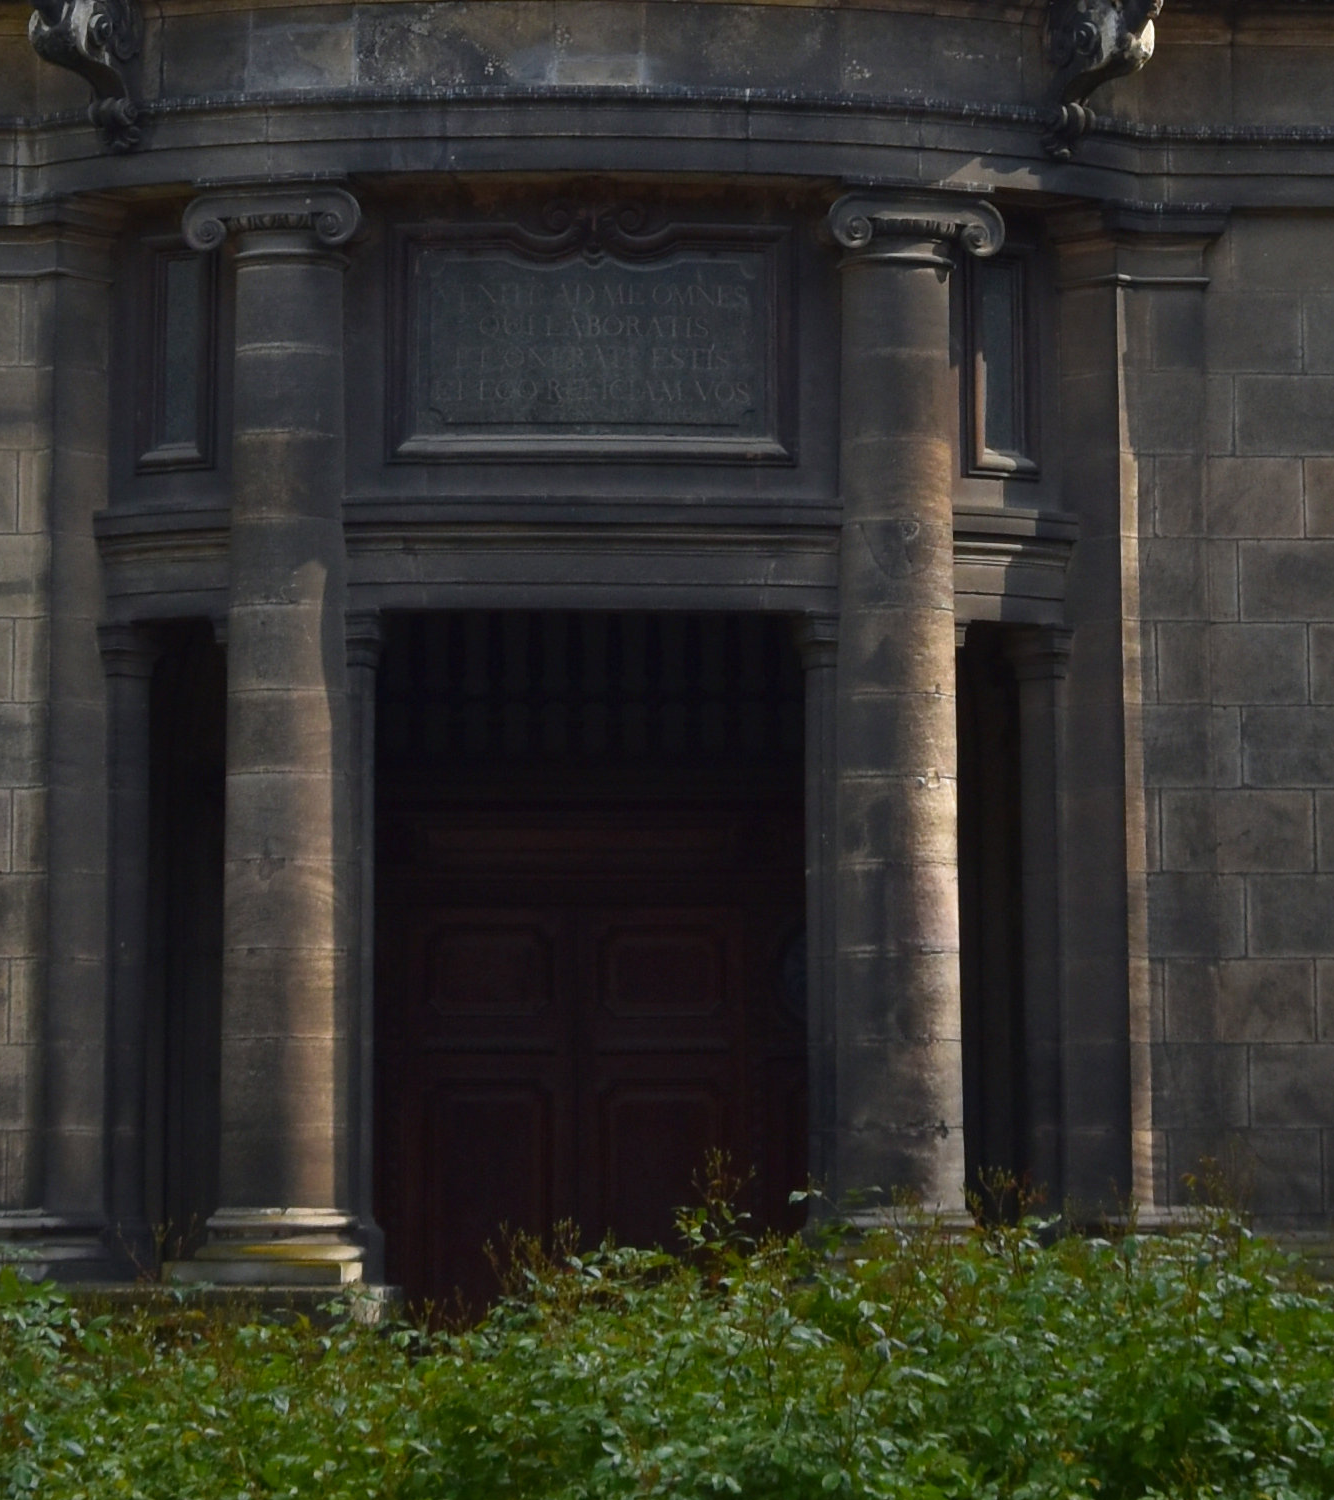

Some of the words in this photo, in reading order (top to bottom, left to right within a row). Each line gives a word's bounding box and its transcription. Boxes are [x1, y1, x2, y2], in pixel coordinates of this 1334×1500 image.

[556, 283, 595, 306] AD
[602, 283, 645, 305] ME
[652, 283, 748, 307] OMNES
[478, 314, 537, 340] QUI
[545, 314, 709, 338] LABORATIS
[453, 346, 491, 369] ET
[502, 345, 636, 370] ONERATI
[652, 346, 731, 371] ESTIS
[478, 378, 538, 402] EGO
[693, 380, 752, 405] VOS
